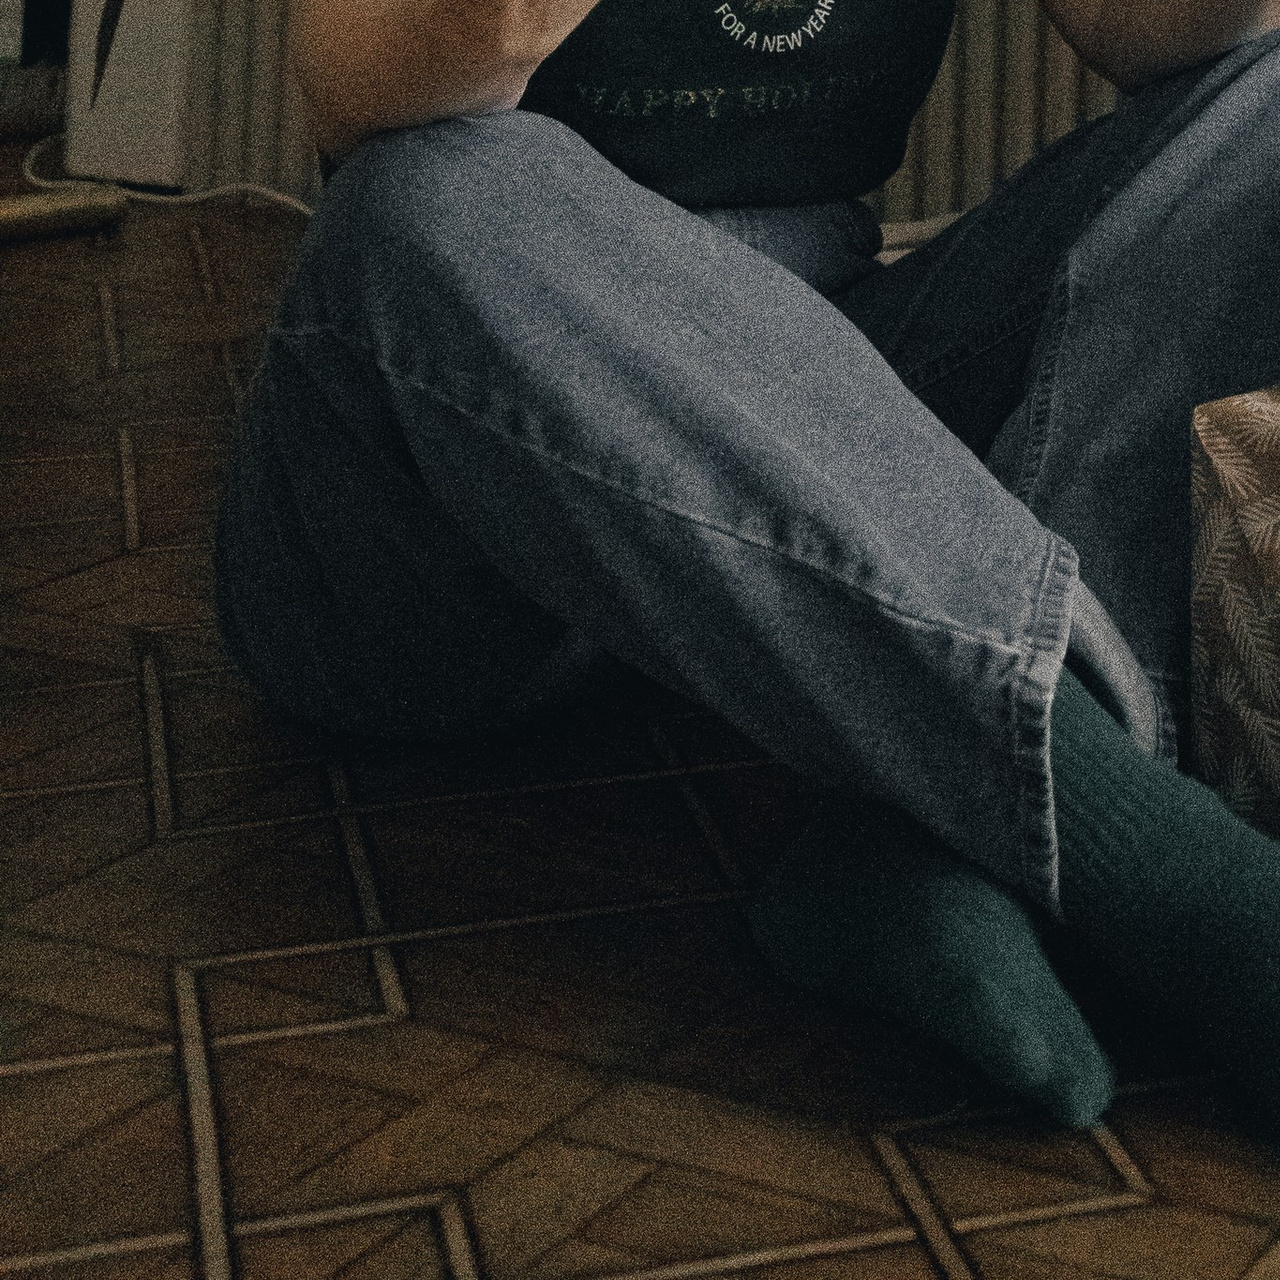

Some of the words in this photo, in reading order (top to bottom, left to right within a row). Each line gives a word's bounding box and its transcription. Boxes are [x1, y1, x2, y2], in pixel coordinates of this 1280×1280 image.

[713, 1, 747, 42] FOR
[742, 30, 758, 51] A
[760, 28, 804, 54] NEW
